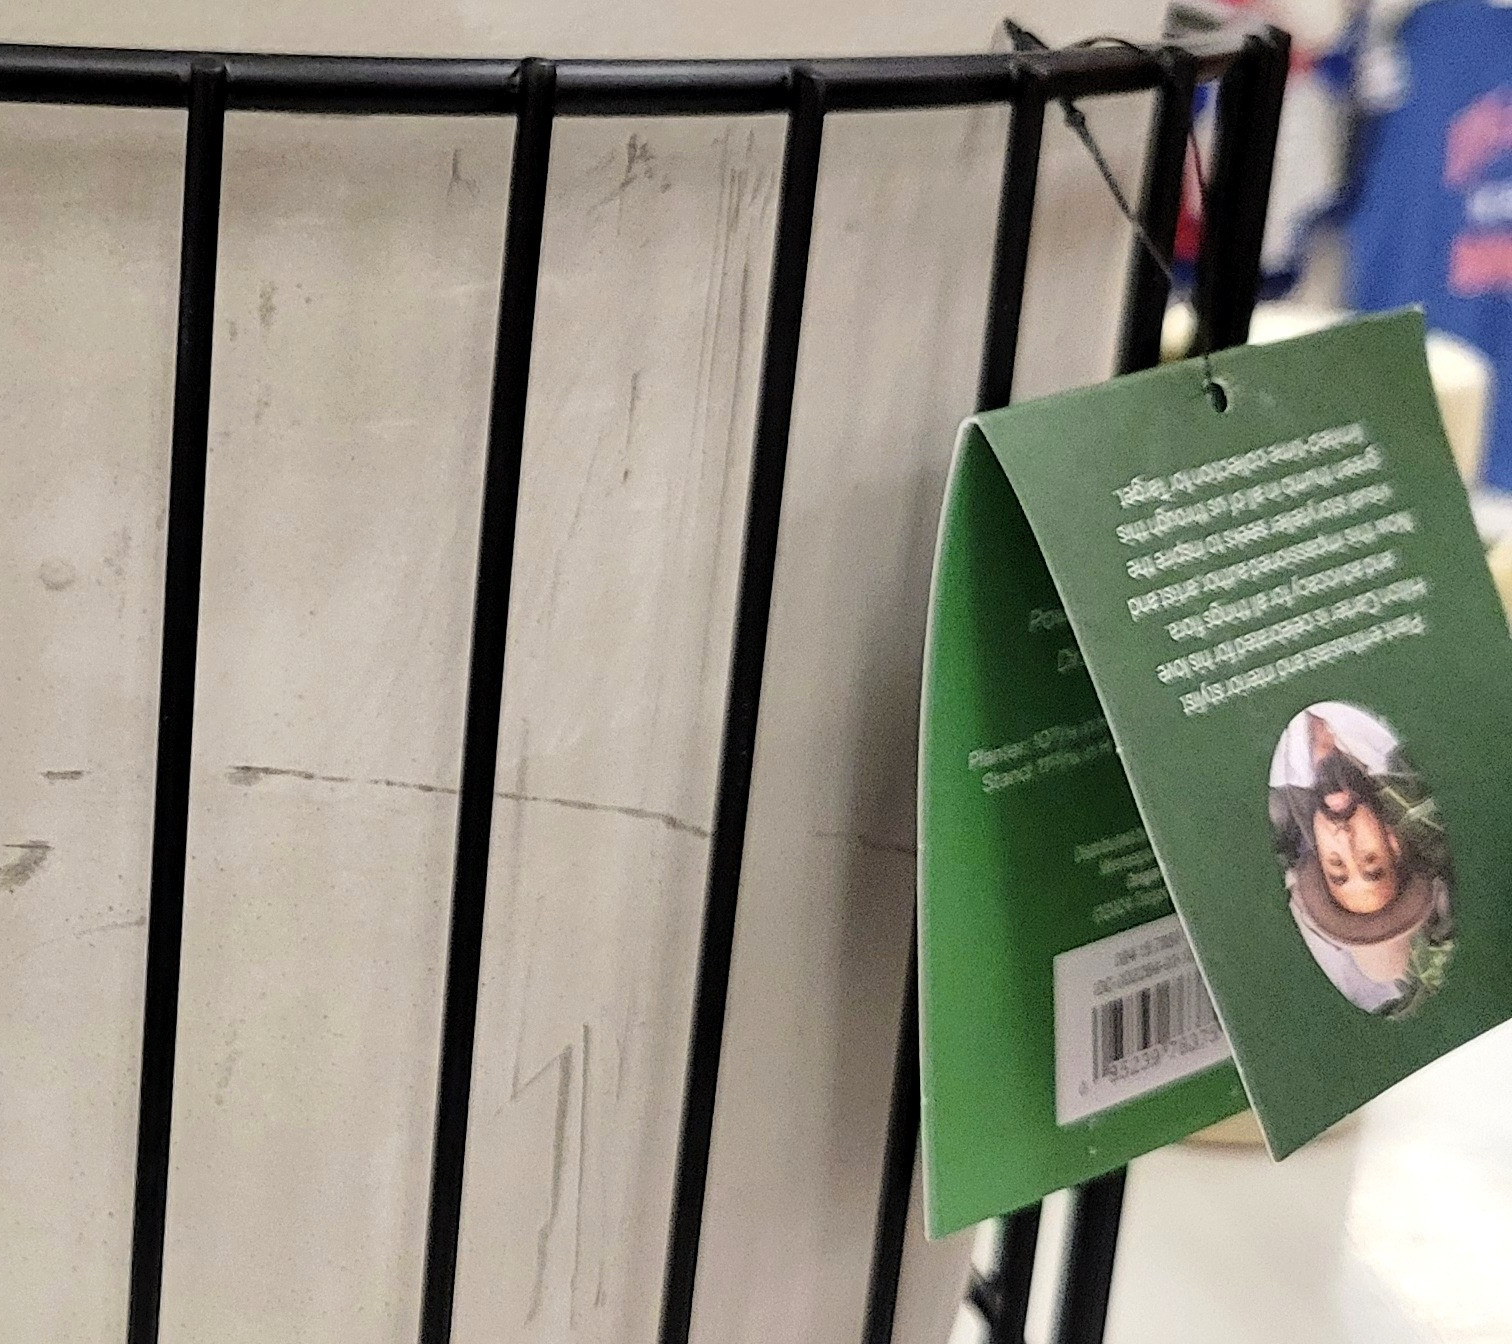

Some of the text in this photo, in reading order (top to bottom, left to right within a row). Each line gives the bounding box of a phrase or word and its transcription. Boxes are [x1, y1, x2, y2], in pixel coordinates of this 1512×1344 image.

[1191, 449, 1267, 484] collection
[1331, 446, 1381, 478] green
[1169, 471, 1195, 493] for
[1281, 466, 1333, 496] thumb
[1244, 484, 1266, 509] all
[1346, 484, 1391, 512] visual
[1116, 520, 1150, 545] this
[1148, 503, 1210, 536] through
[1222, 519, 1269, 548] seeks
[1344, 522, 1376, 546] this
[1375, 511, 1413, 533] Now
[1126, 556, 1157, 578] the
[1154, 540, 1207, 569] inspire
[1250, 533, 1345, 578] impassioned
[1362, 550, 1396, 578] and
[1158, 577, 1200, 607] artist
[1291, 560, 1363, 596] advocacy
[1377, 577, 1426, 604] Hilton
[1127, 590, 1160, 621] and
[1248, 592, 1270, 617] all
[1269, 585, 1294, 607] for
[1331, 590, 1380, 620] Carter
[1203, 599, 1252, 628] things
[1234, 613, 1314, 659] celebrated
[1187, 650, 1215, 673] his
[1213, 641, 1237, 664] for
[1275, 651, 1308, 681] and
[1157, 657, 1191, 682] love
[1225, 664, 1277, 695] interior
[1180, 682, 1228, 715] stylist
